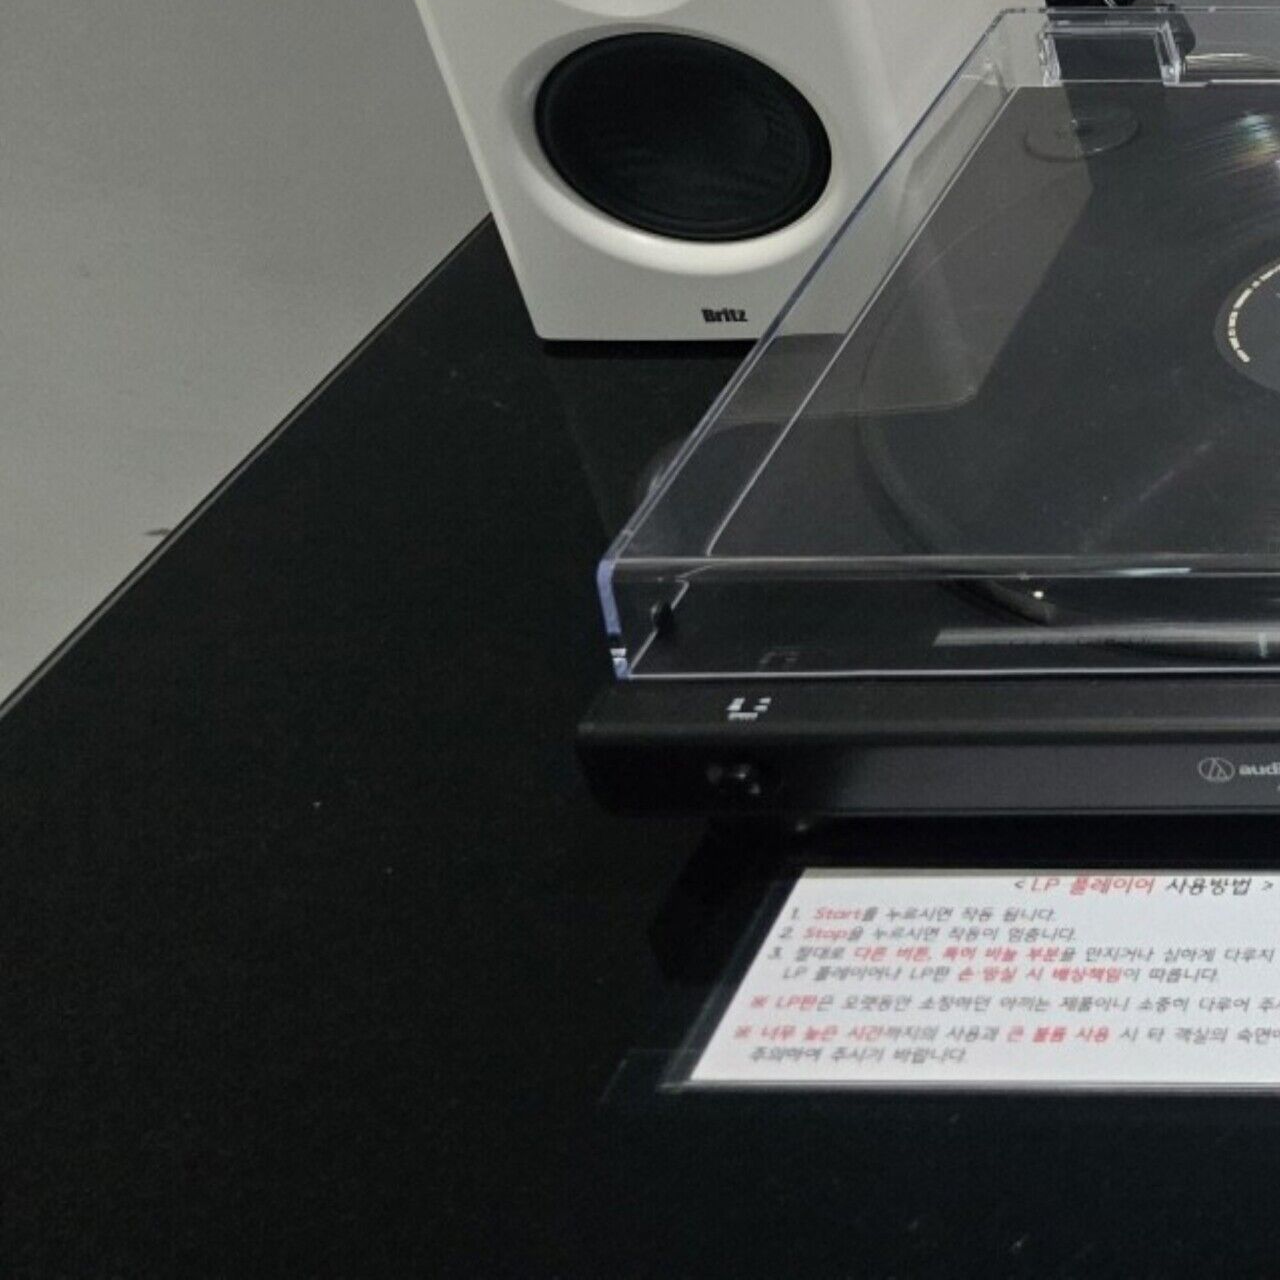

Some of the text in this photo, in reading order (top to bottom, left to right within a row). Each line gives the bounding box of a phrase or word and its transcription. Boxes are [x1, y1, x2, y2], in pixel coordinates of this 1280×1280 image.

[1031, 878, 1060, 891] LP
[1070, 875, 1156, 895] 플레이어
[1165, 877, 1252, 896] 사용방법
